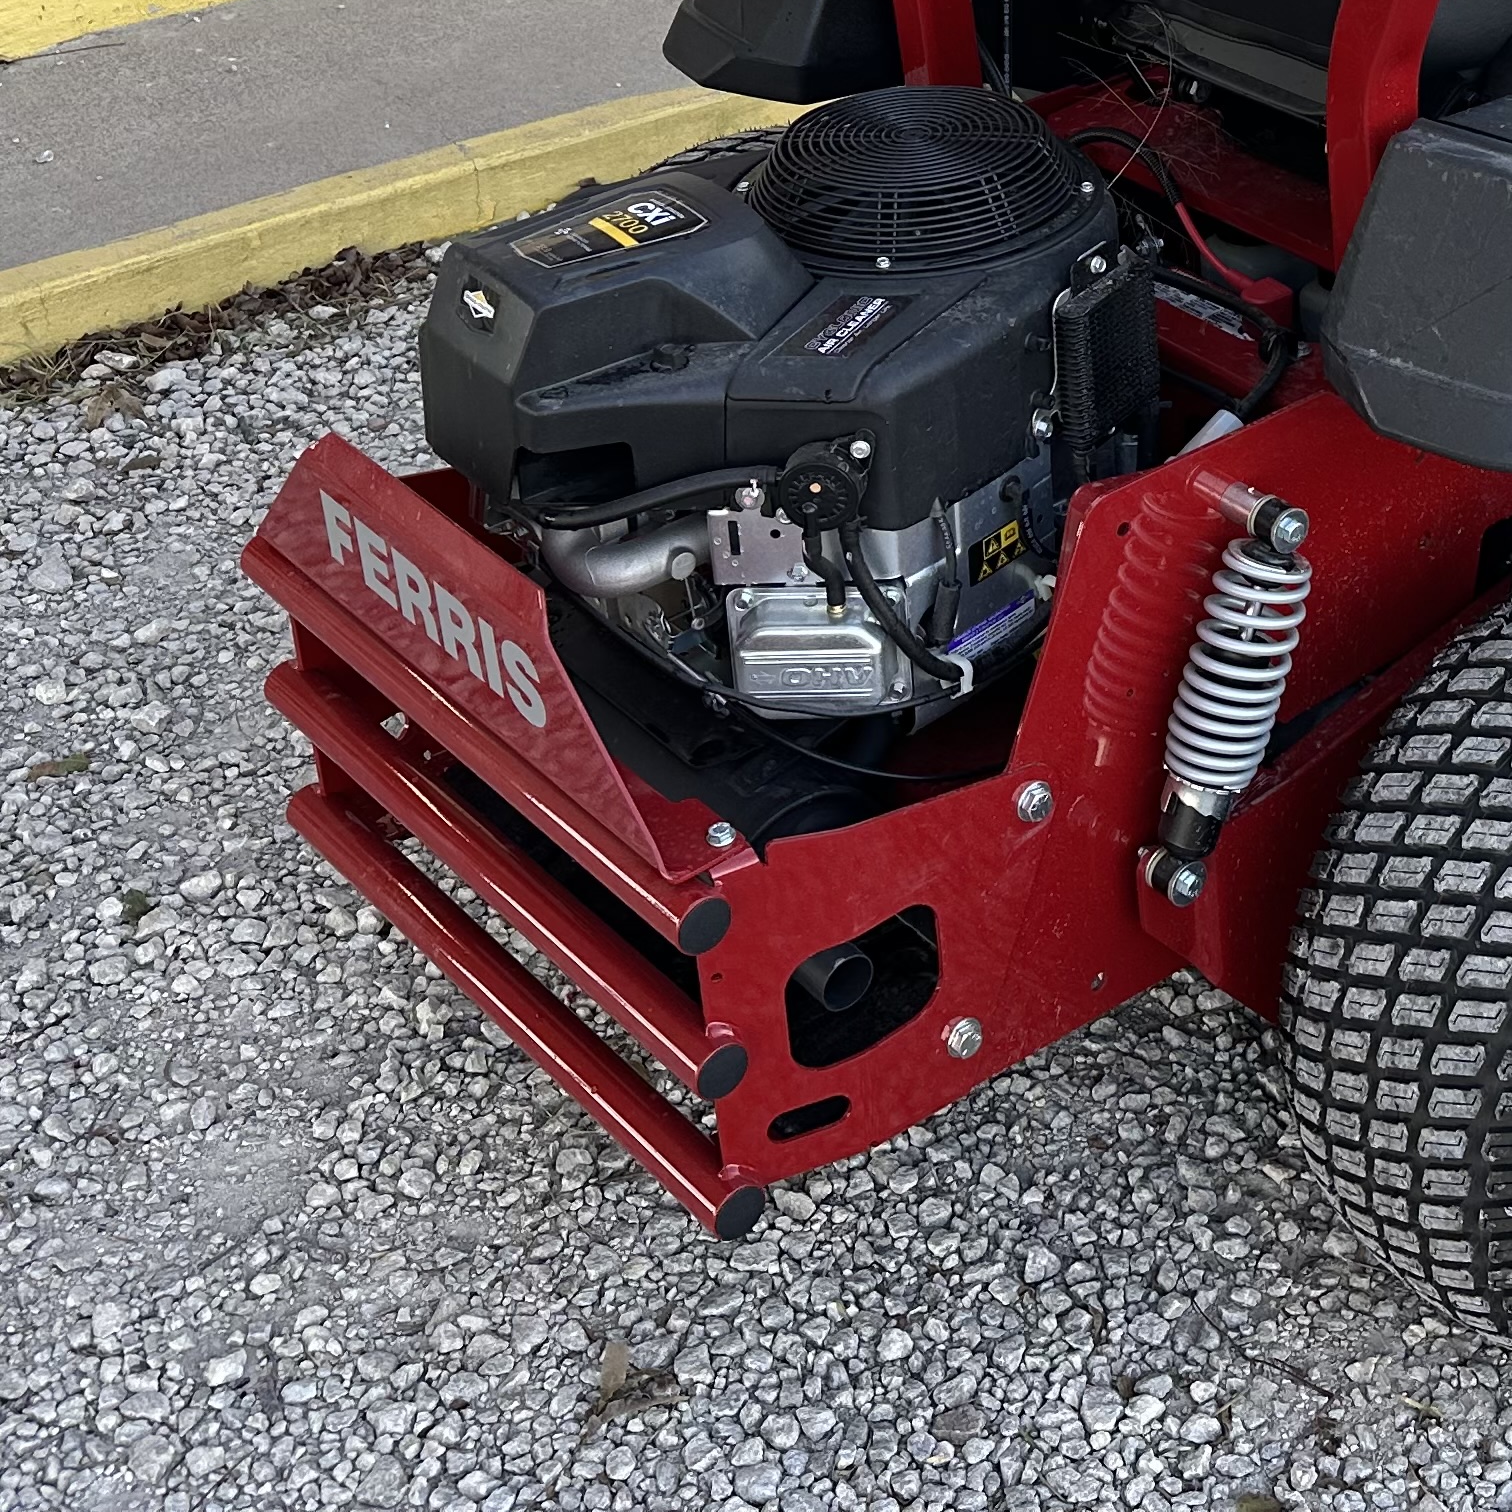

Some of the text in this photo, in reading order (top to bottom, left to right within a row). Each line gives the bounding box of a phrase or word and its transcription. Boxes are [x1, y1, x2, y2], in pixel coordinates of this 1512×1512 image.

[602, 210, 649, 235] 2700
[818, 298, 886, 354] AIR CLEANER
[319, 488, 547, 729] FERRIS
[780, 666, 874, 687] OHV
